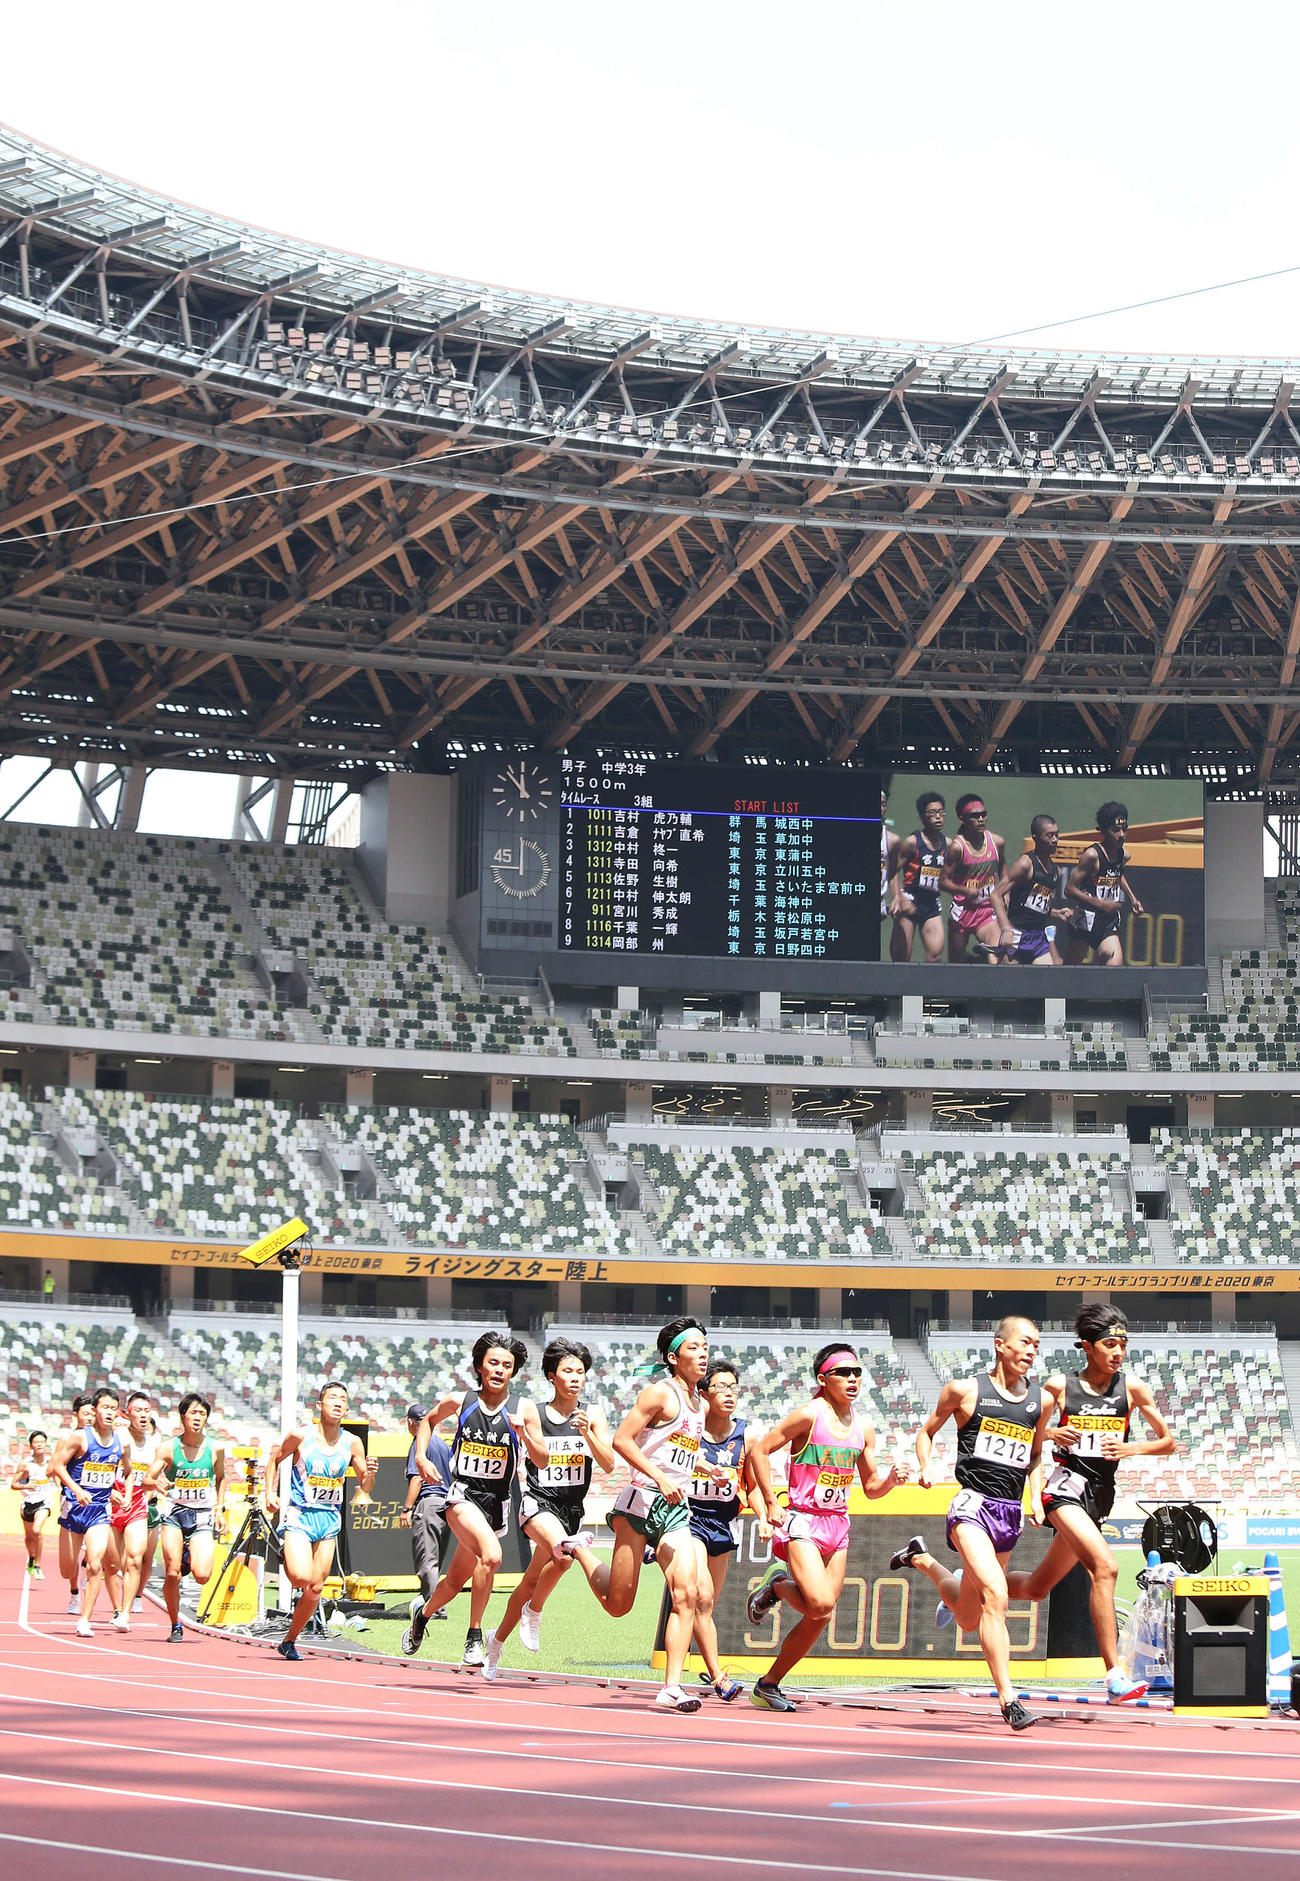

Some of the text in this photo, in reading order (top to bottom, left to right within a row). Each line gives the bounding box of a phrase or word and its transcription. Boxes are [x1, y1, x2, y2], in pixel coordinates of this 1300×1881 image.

[562, 760, 646, 776] 男子 中学3年
[564, 777, 626, 790] 1500m
[560, 791, 654, 808] タイムレース 3組
[734, 800, 800, 814] START LIST
[568, 808, 572, 818] 1
[588, 809, 612, 820] 1011
[614, 810, 640, 823] 吉村
[774, 818, 813, 831] 城西中
[566, 824, 573, 834] 2
[588, 824, 612, 836] 1111
[614, 826, 640, 839] 吉倉
[774, 833, 813, 846] 草加中
[494, 848, 512, 862] 45
[566, 839, 573, 850] 3
[588, 840, 612, 852] 1312
[614, 842, 640, 855] 中村
[566, 855, 572, 866] 4
[587, 856, 611, 868] 1311
[614, 857, 638, 870] 寺田
[653, 860, 678, 872] 向希
[774, 864, 826, 878] 立川五中
[566, 870, 572, 882] 5
[586, 872, 612, 884] 1113
[612, 873, 639, 886] 佐野
[775, 880, 866, 896] さいたま宮前中
[566, 887, 572, 898] 6
[586, 888, 611, 900] 1211
[614, 889, 638, 902] 中村
[652, 891, 692, 904] 伸太朗
[774, 896, 813, 909] 海神中
[566, 902, 572, 914] 7
[592, 904, 611, 916] 911
[612, 905, 638, 918] 宮川
[652, 906, 678, 920] 秀成
[774, 912, 826, 926] 若松原中
[565, 918, 572, 930] 8
[586, 920, 612, 932] 1116
[612, 921, 638, 934] 千葉
[774, 928, 839, 942] 坂戸若宮中
[564, 934, 572, 946] 9
[586, 936, 612, 948] 1314
[612, 936, 638, 950] 岡部
[652, 938, 664, 951] 州
[775, 944, 826, 956] 日野四中
[255, 1234, 288, 1260] SEIKO
[324, 1256, 360, 1268] 2020
[361, 1257, 384, 1269] 東京
[405, 1256, 608, 1281] ライジングスター陸上
[1214, 1276, 1250, 1287] 2020
[1252, 1275, 1275, 1287] 東京
[984, 1420, 1032, 1442] SEIKO
[1070, 1418, 1123, 1430] SEIKO
[463, 1442, 506, 1458] SEIKO
[548, 1440, 584, 1451] 川五中
[984, 1435, 1026, 1462] 1212
[84, 1462, 114, 1472] SEIKO
[464, 1456, 502, 1474] 1112
[550, 1454, 584, 1464] EIKO
[672, 1448, 695, 1470] 1011
[86, 1472, 112, 1484] 1312
[545, 1466, 581, 1481] 1311
[1058, 1470, 1072, 1492] 2
[175, 1480, 208, 1488] SEIKO
[692, 1480, 732, 1496] 1113
[178, 1489, 206, 1500] 1116
[312, 1487, 340, 1500] 1211
[956, 1492, 972, 1512] 2
[788, 1513, 797, 1532] 7
[1248, 1527, 1285, 1536] POCARI
[1192, 1580, 1250, 1592] SEIKO
[216, 1602, 252, 1610] SEIKO
